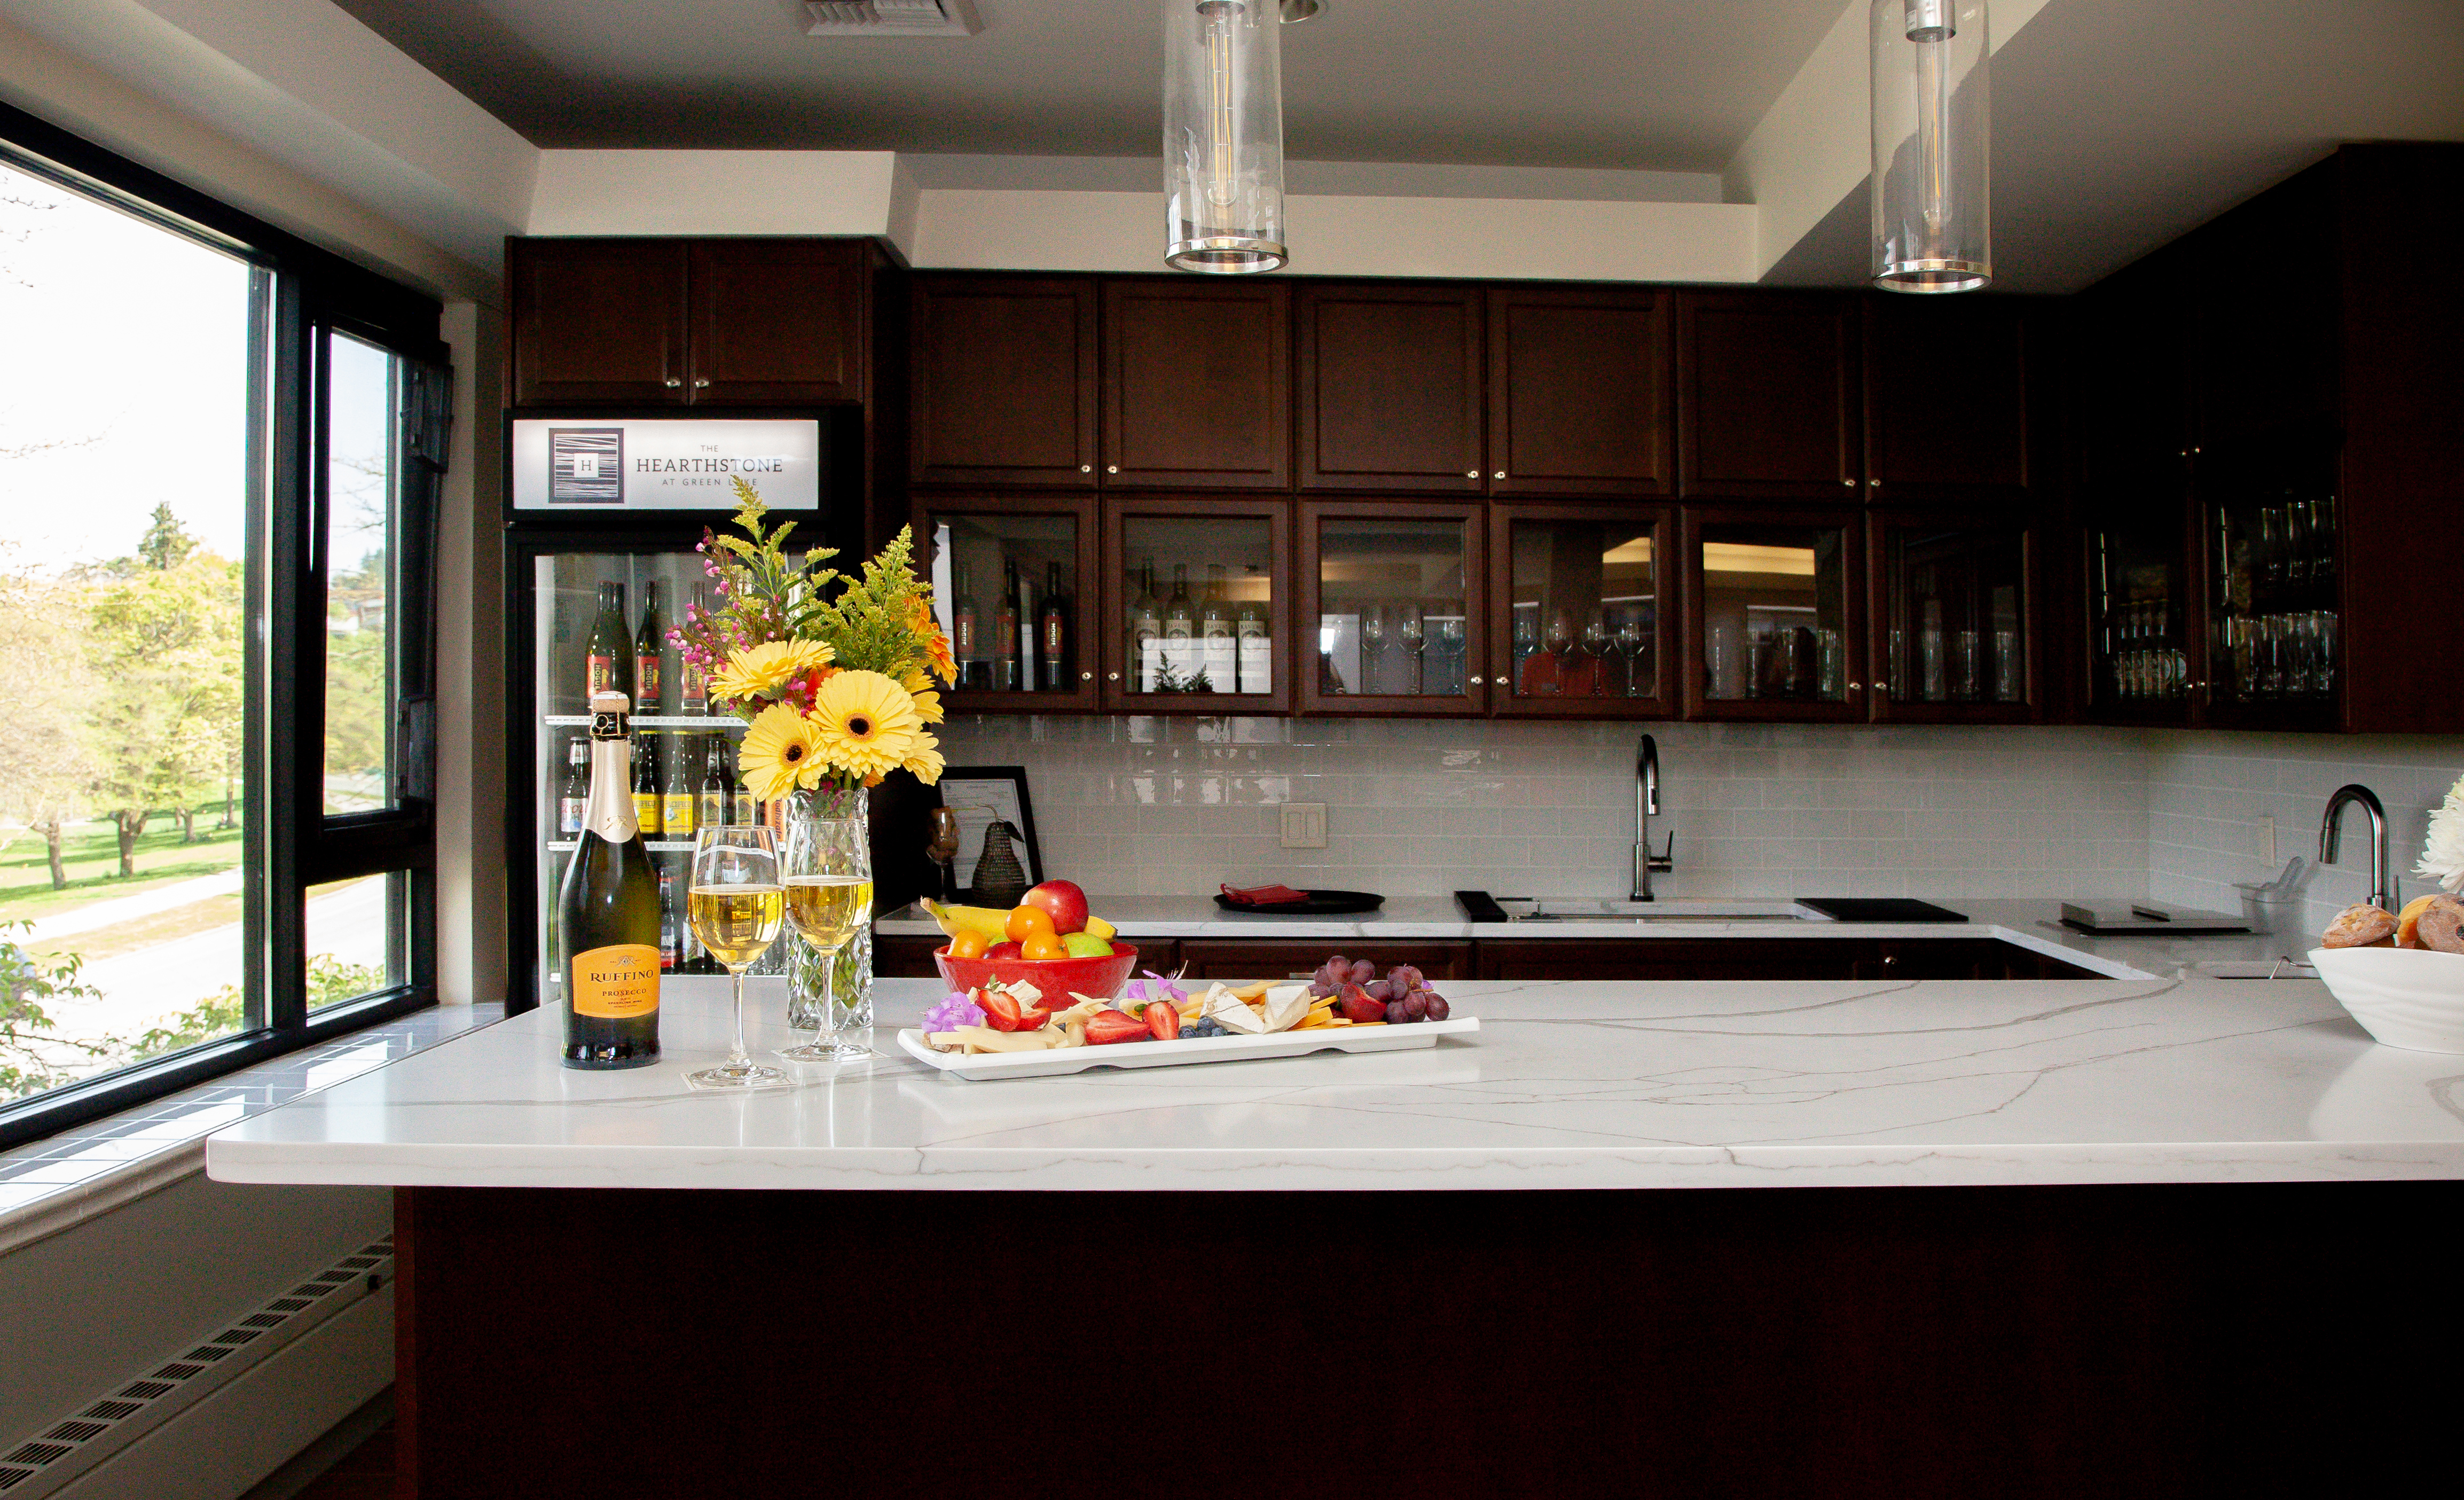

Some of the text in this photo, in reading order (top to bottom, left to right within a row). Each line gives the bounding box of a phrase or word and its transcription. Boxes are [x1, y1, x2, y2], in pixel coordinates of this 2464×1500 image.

[581, 460, 592, 471] H
[636, 458, 783, 472] HEARTHSTONE
[682, 478, 721, 486] GREEN
[590, 969, 654, 983] RUFFINO
[602, 988, 647, 997] PROSECCO
